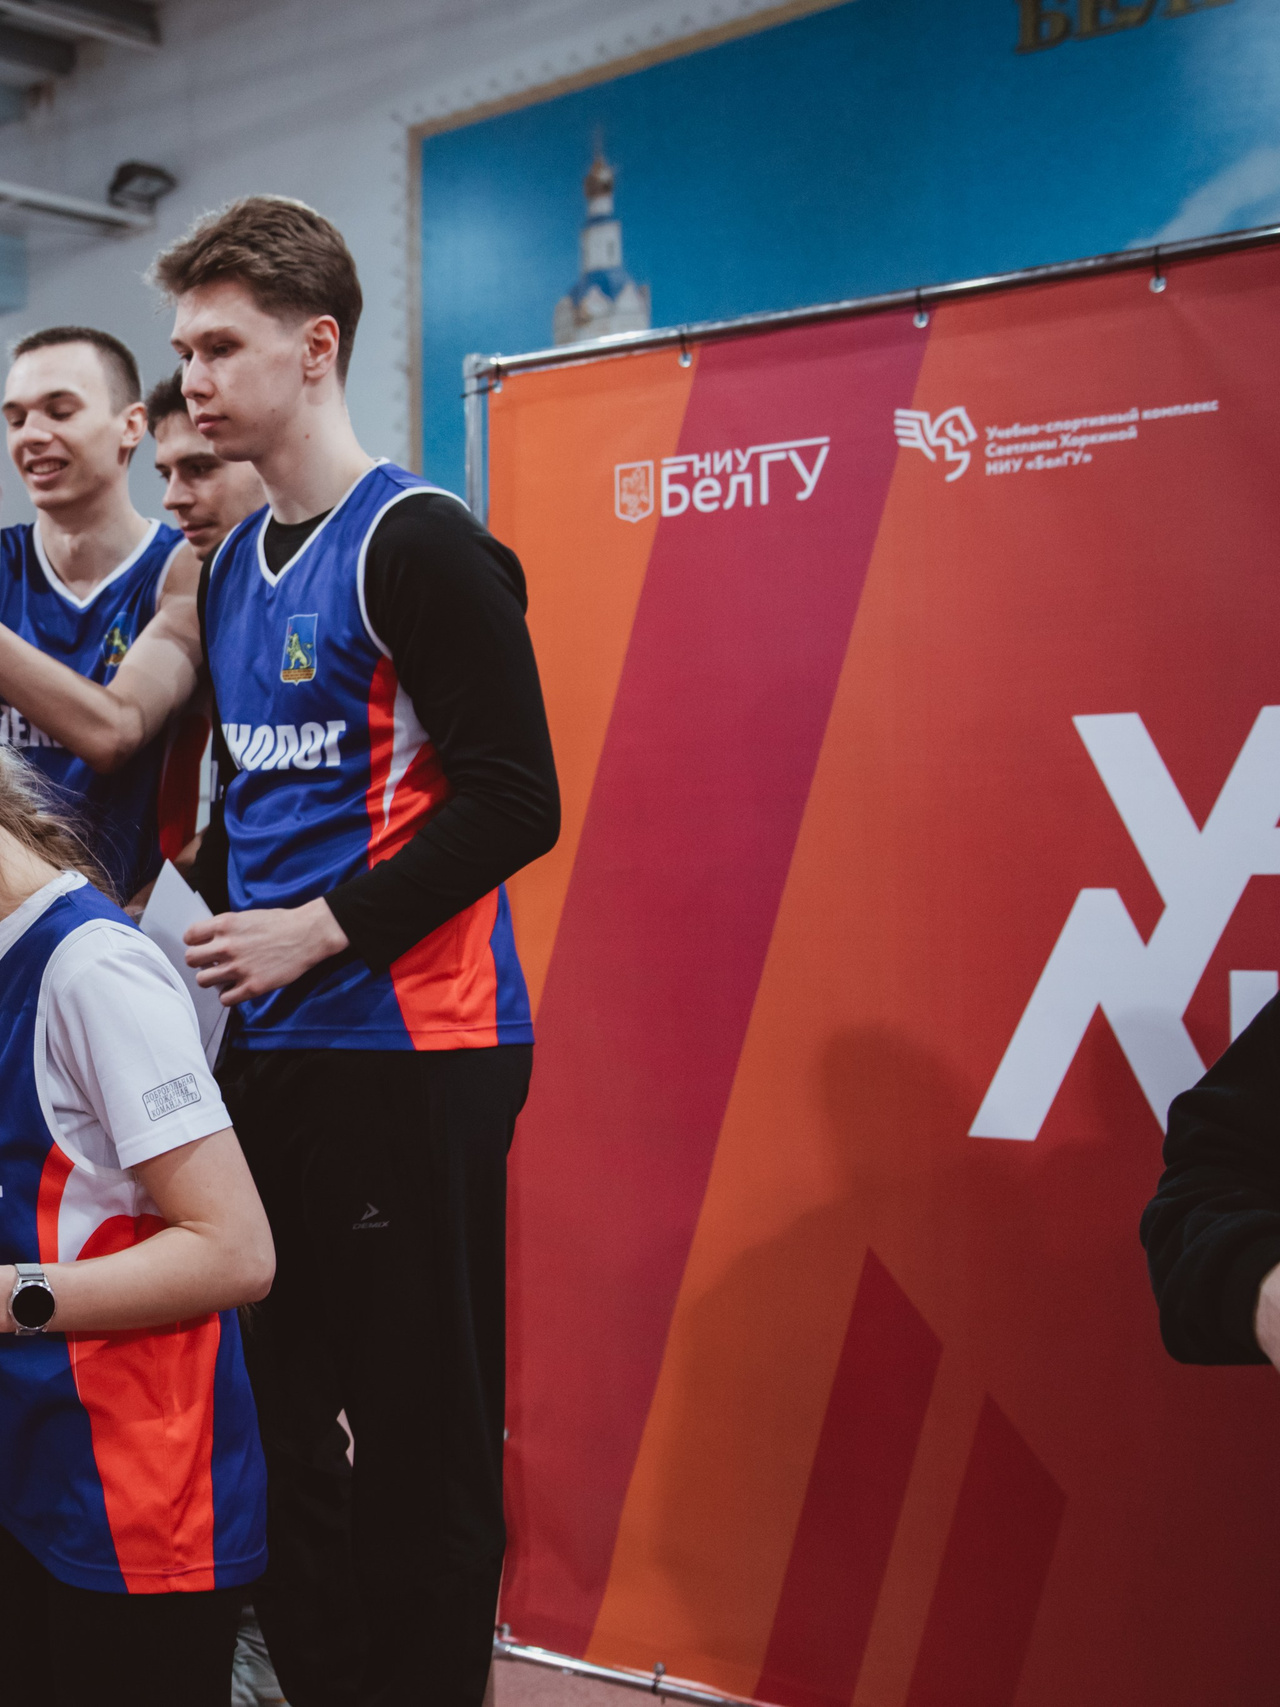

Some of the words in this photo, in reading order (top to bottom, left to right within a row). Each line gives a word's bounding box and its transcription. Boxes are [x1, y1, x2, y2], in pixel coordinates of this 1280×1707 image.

[693, 449, 754, 478] НИУ
[985, 457, 1023, 476] НИУ
[661, 444, 830, 517] БелГУ
[221, 720, 346, 771] НОЛОГ
[145, 1075, 194, 1104] ДОБРОВОЛЬНАЯ
[352, 1220, 390, 1230] DEMIX
